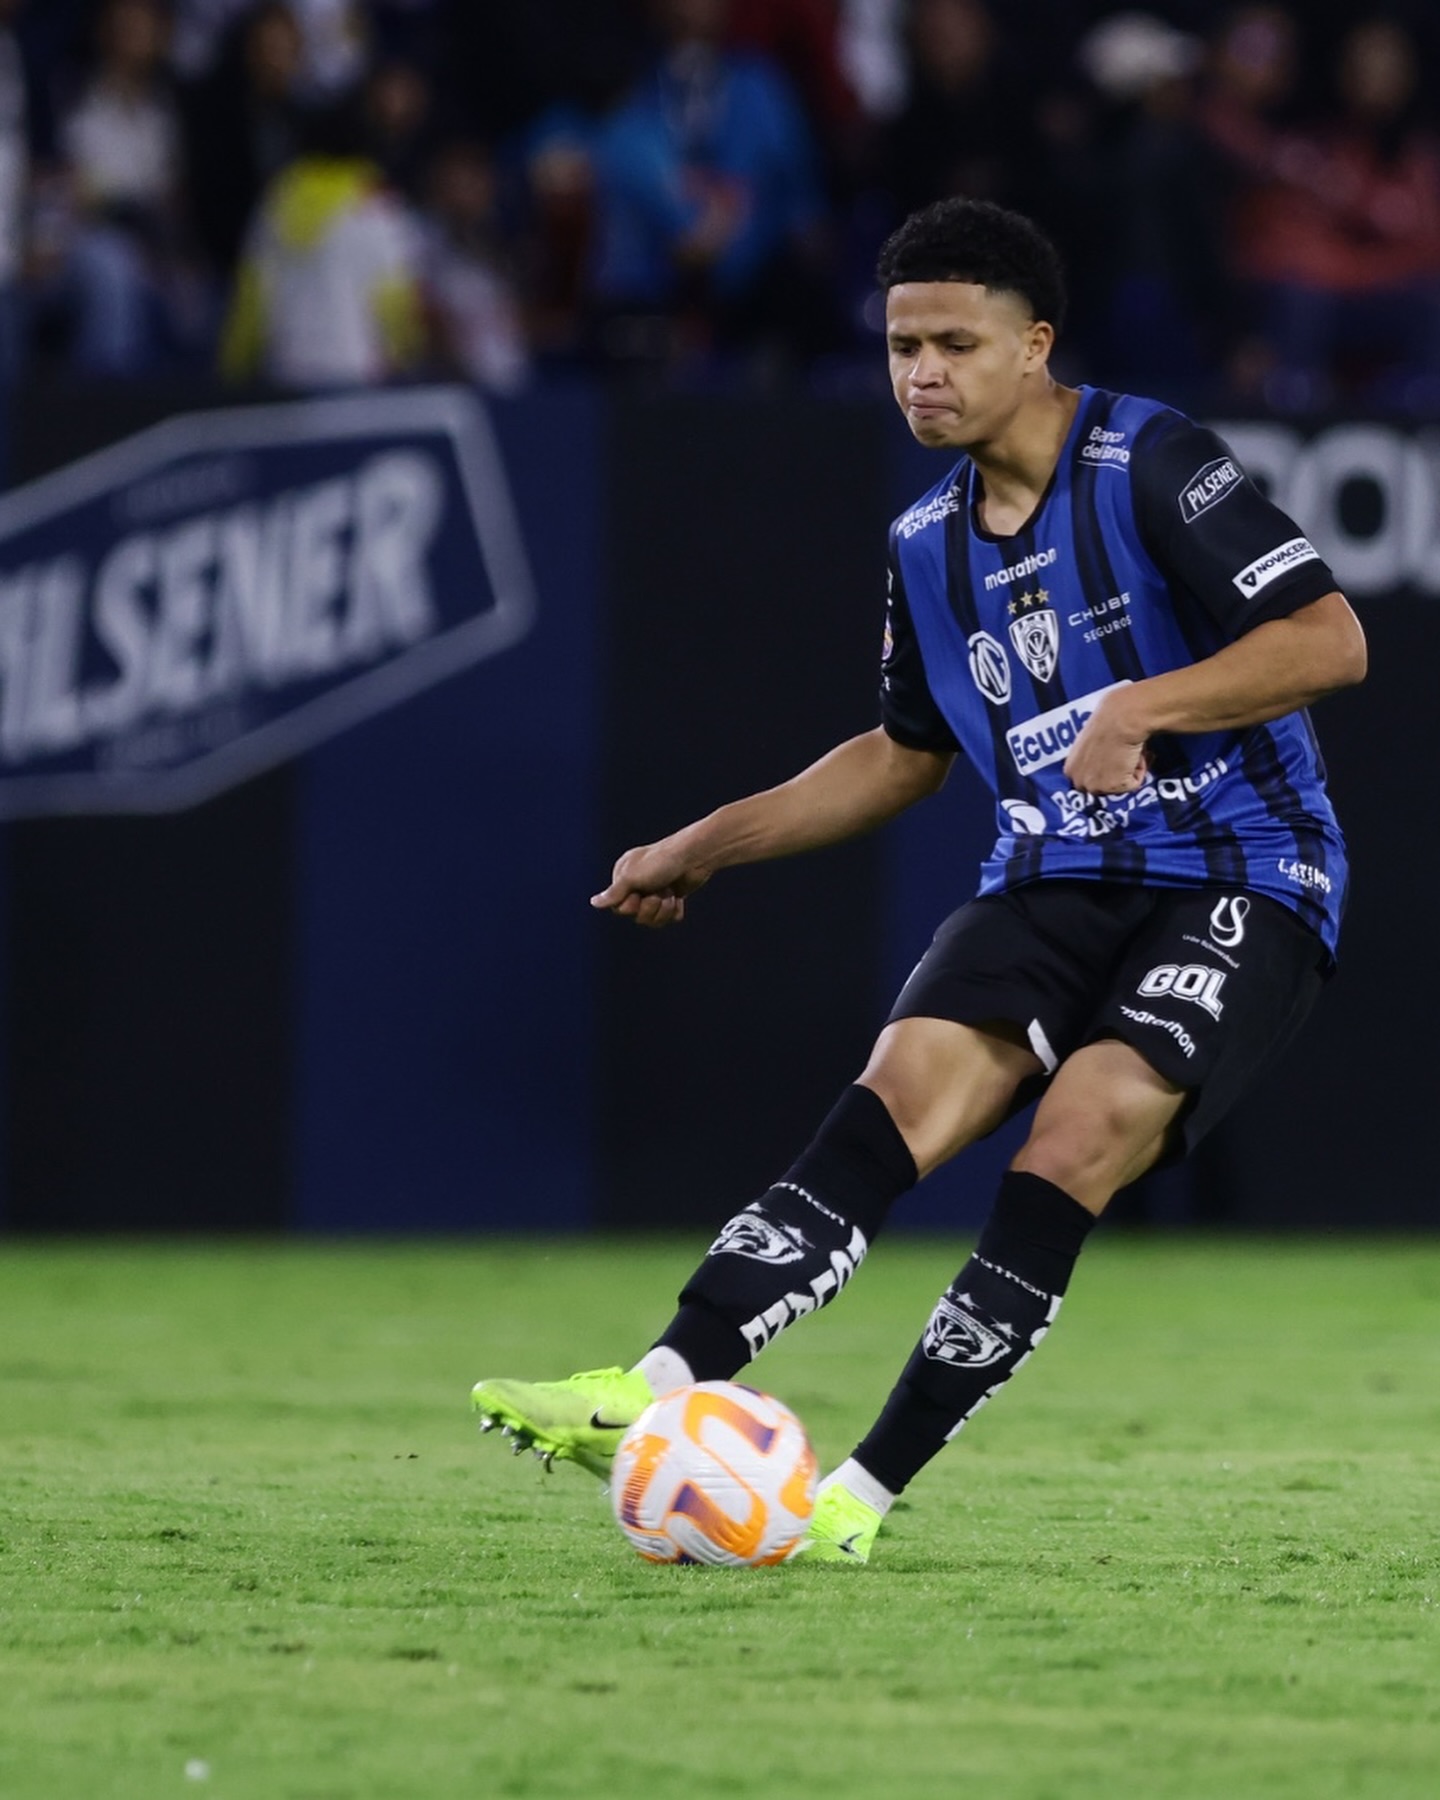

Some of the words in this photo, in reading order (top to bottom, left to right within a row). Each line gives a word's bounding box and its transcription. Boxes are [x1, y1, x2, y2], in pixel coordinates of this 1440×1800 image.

[1187, 461, 1238, 512] PILSENER
[903, 499, 960, 539] EXPRES
[985, 548, 1056, 591] marathon
[1256, 541, 1311, 574] NOVACER
[1068, 592, 1131, 627] CHUBB
[1083, 614, 1132, 643] SEGUROS
[1010, 708, 1094, 767] Ecuab
[1137, 964, 1226, 1022] GOL
[1120, 1005, 1195, 1058] marathon
[972, 1252, 1047, 1300] athon
